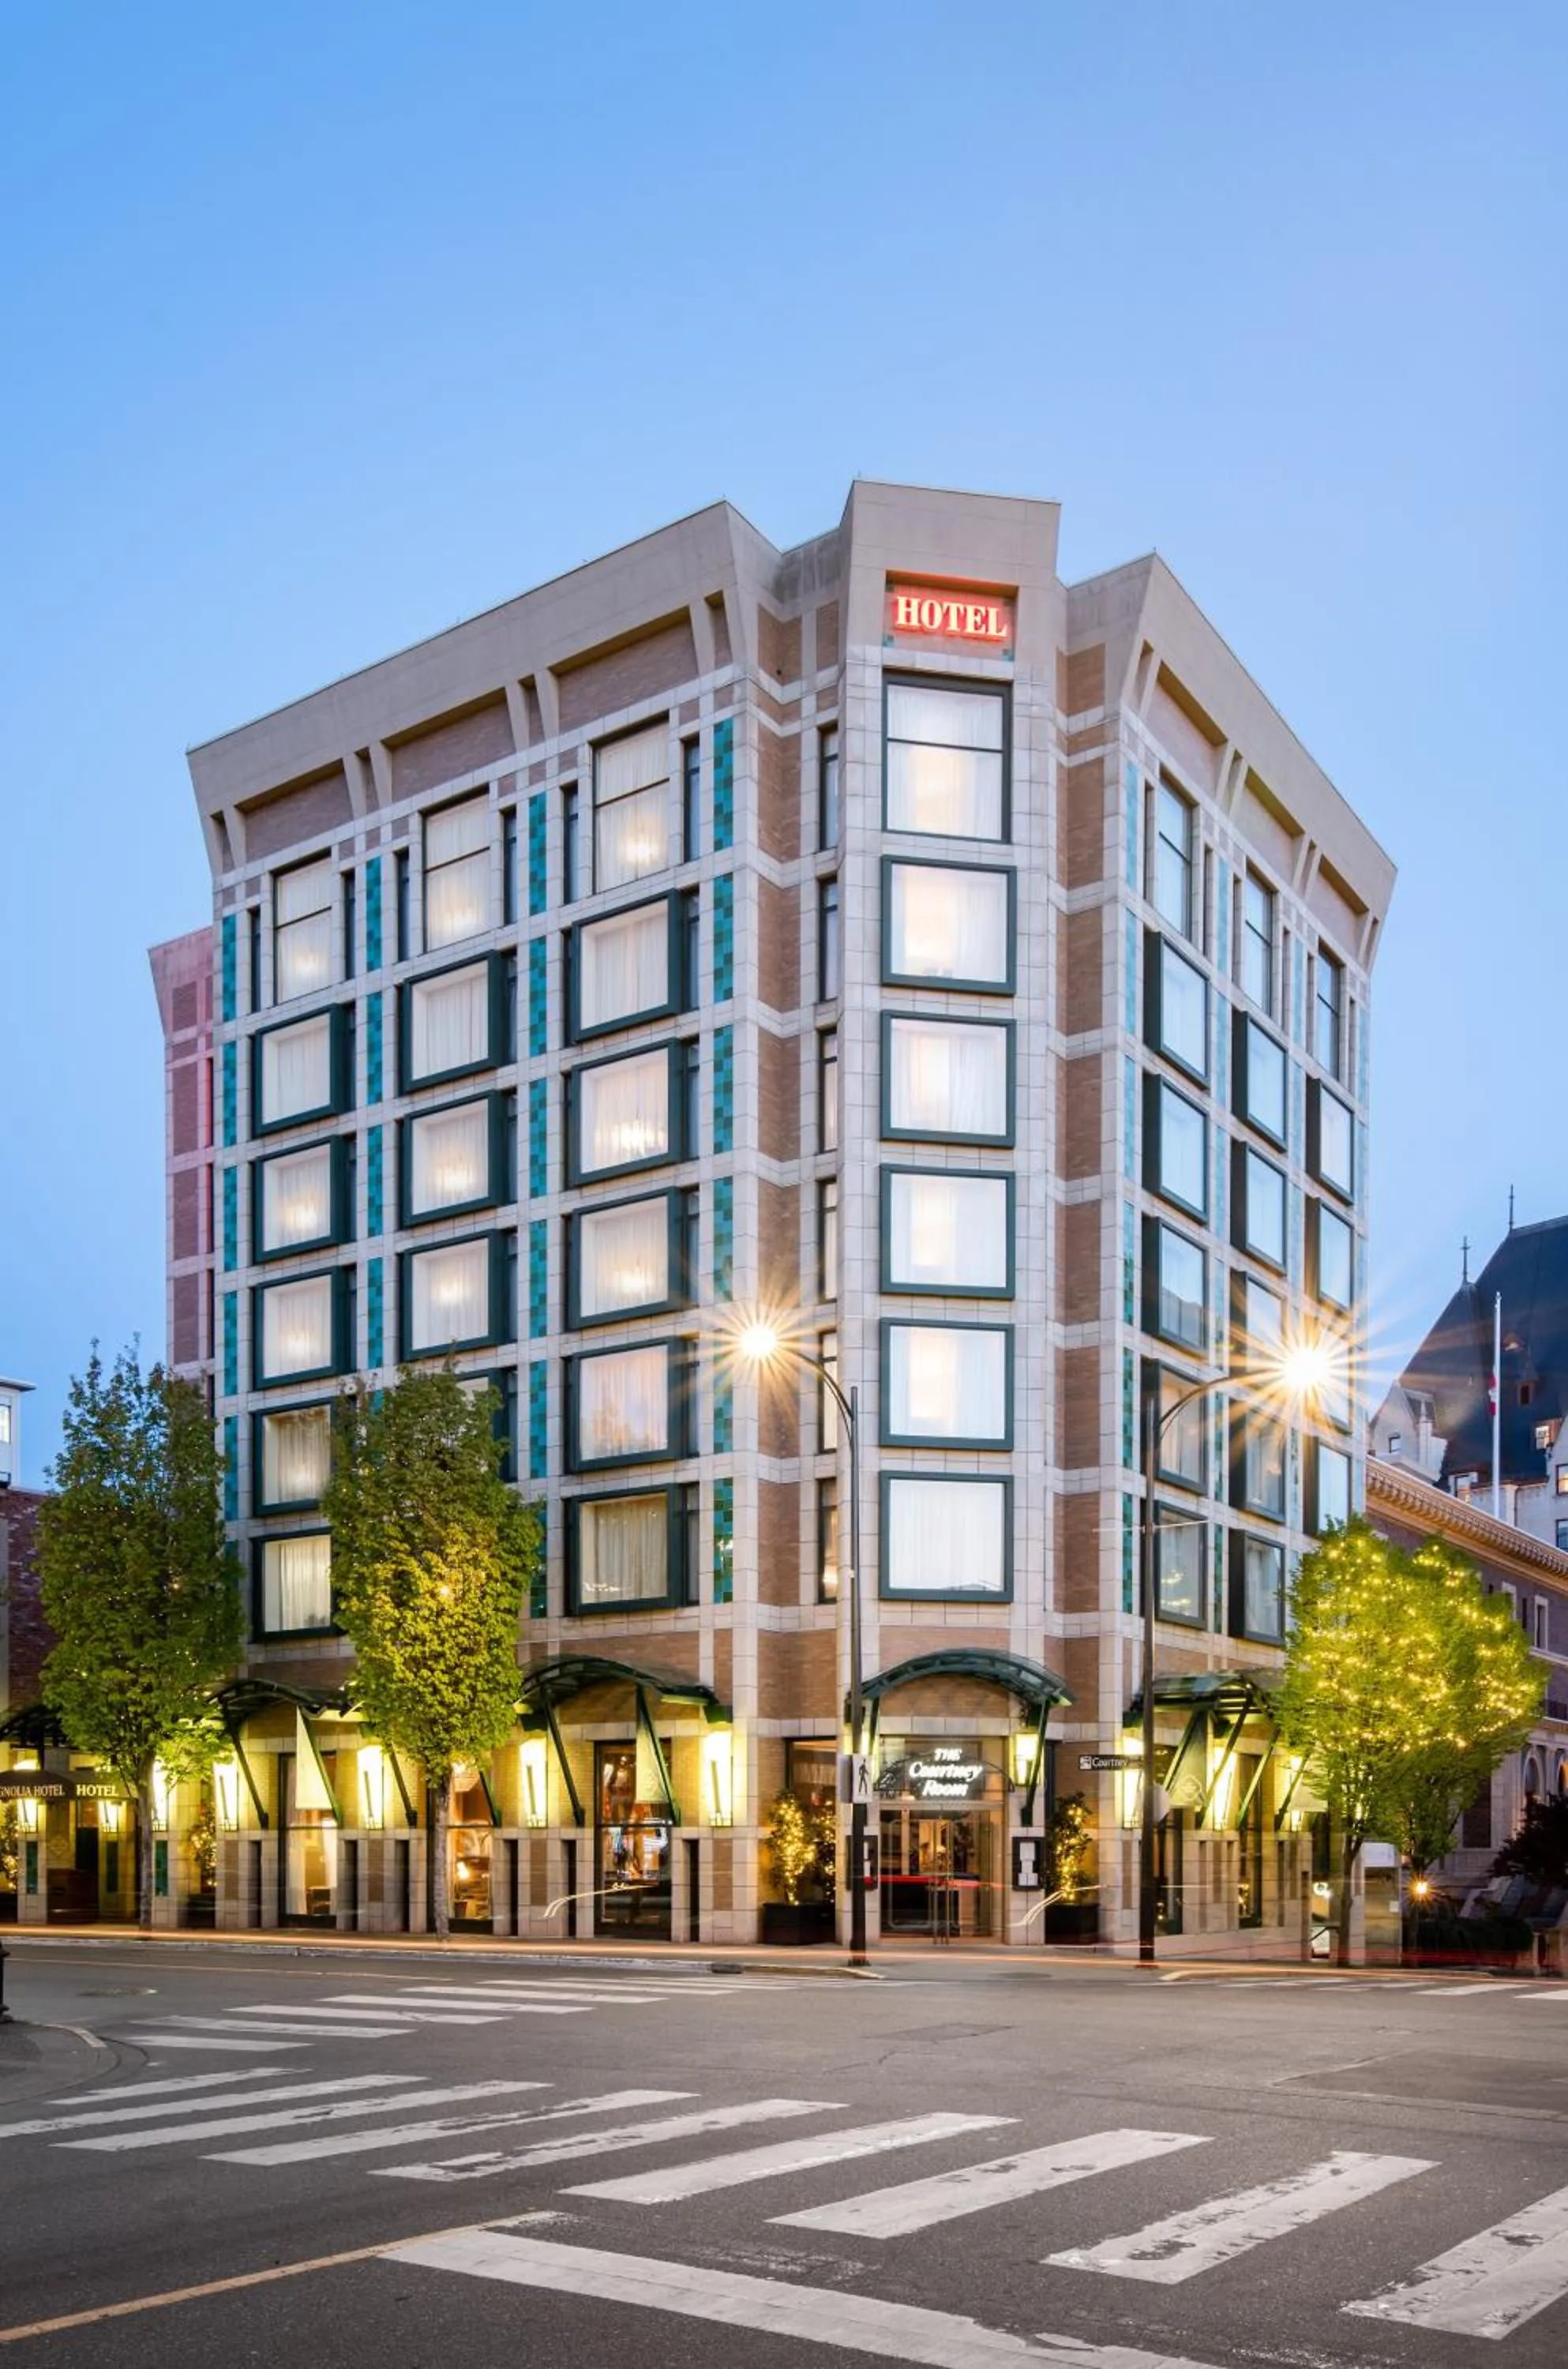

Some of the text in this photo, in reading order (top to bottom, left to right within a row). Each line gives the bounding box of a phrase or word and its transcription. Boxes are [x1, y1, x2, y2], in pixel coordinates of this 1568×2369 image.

[896, 595, 1007, 637] HOTEL
[934, 1748, 962, 1761] THE
[1092, 1757, 1127, 1768] Courtney
[909, 1761, 984, 1782] Courtney
[34, 1785, 65, 1796] HOTEL
[76, 1784, 118, 1796] HOTEL
